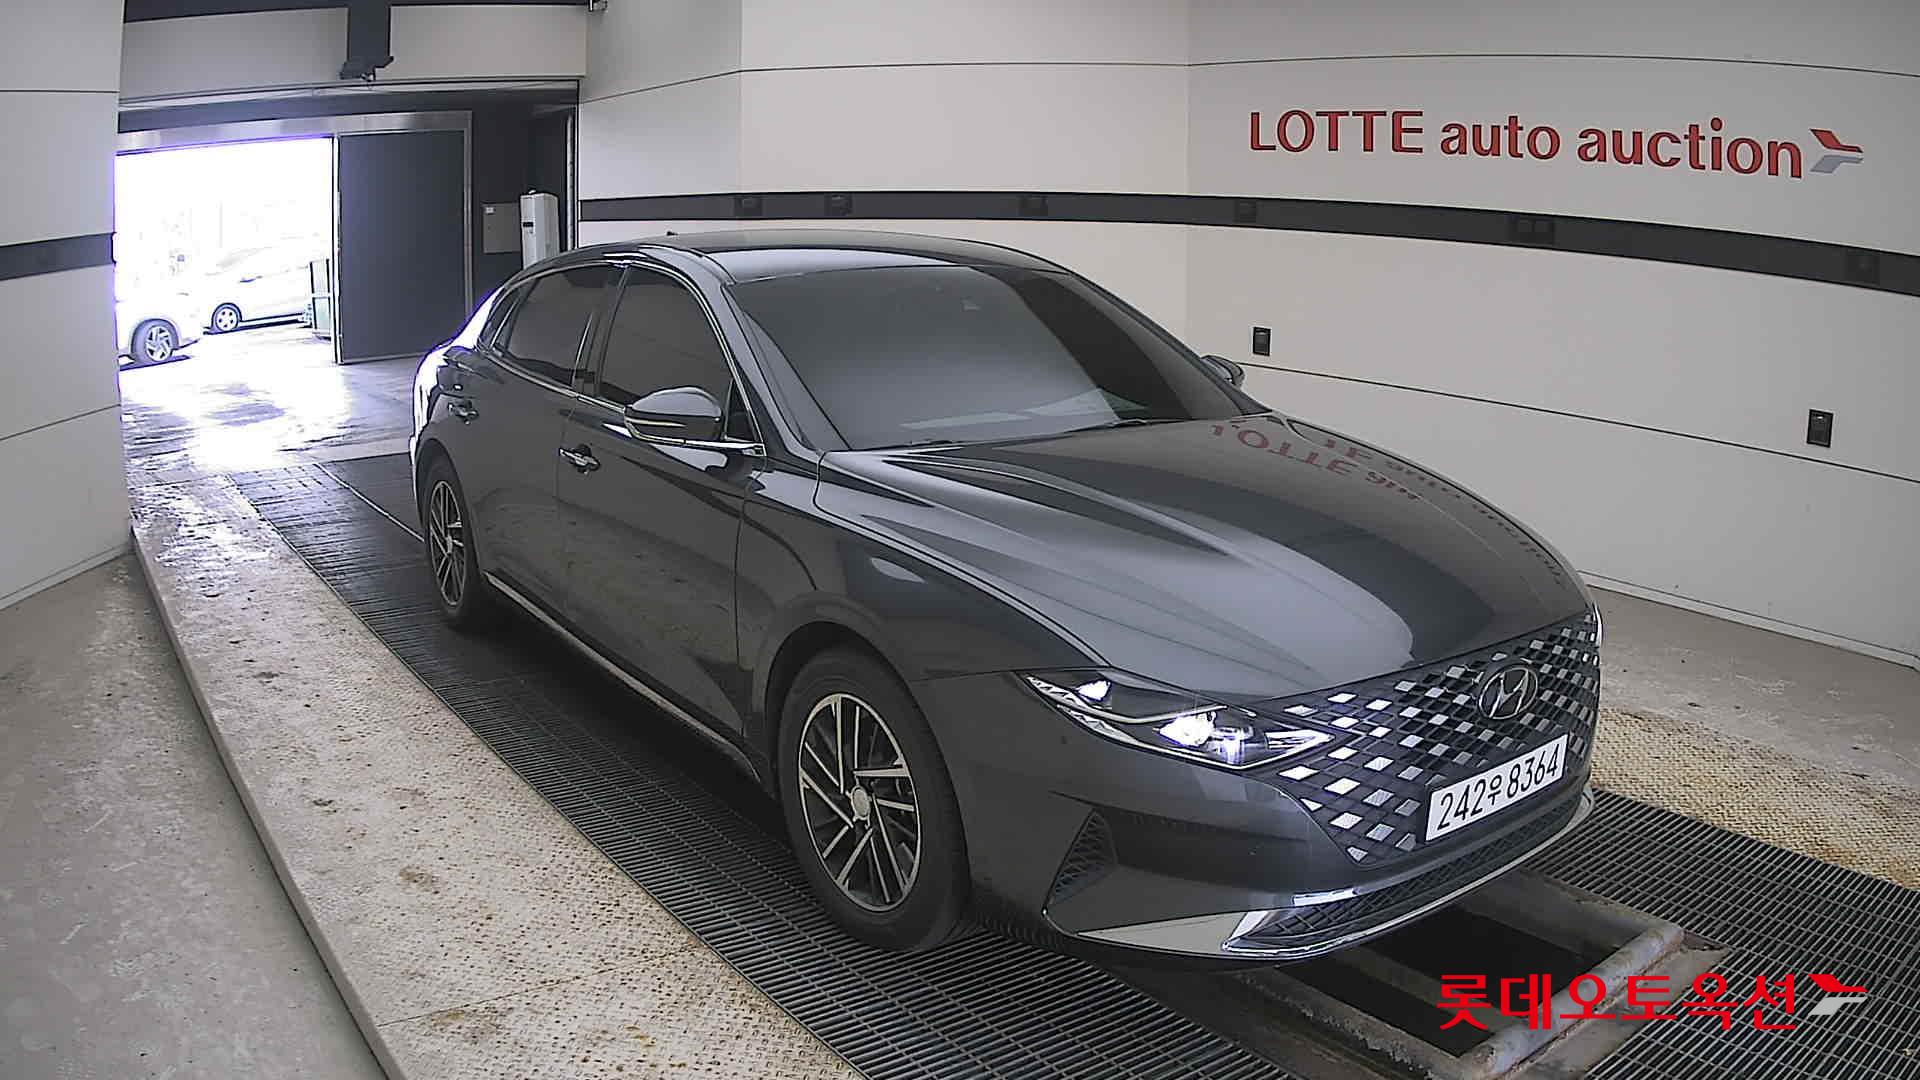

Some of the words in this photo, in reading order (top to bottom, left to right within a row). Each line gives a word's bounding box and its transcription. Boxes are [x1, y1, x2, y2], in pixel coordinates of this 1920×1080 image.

[1250, 110, 1424, 154] LOTTE
[1440, 115, 1560, 160] auto
[1577, 117, 1803, 179] auction
